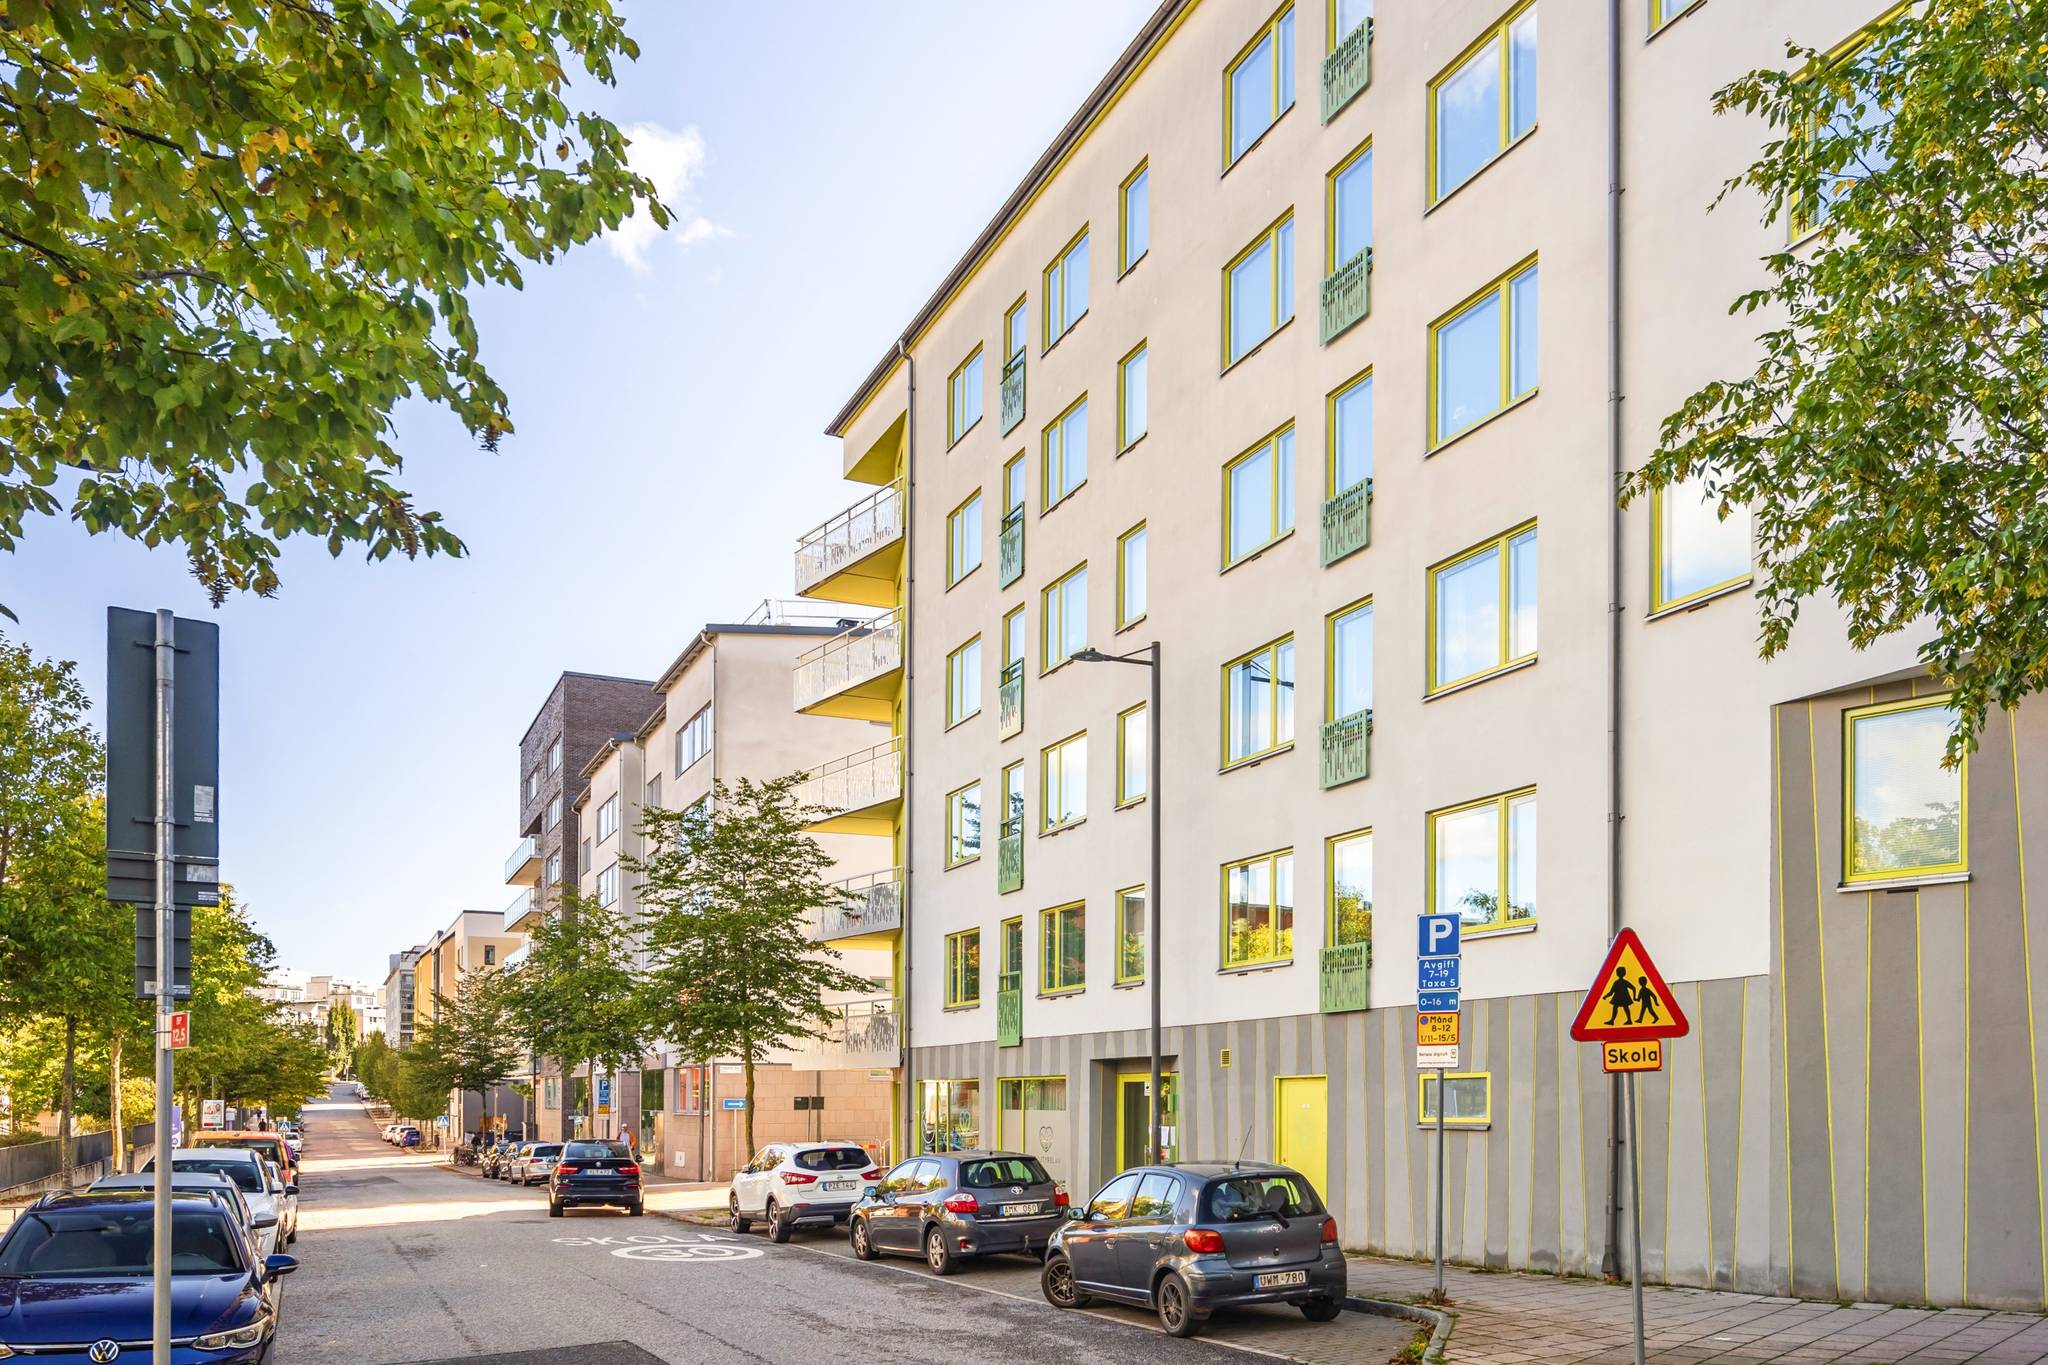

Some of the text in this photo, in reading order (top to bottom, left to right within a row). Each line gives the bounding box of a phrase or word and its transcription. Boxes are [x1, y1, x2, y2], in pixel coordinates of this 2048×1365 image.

[1429, 918, 1453, 953] P
[1423, 960, 1455, 970] Avgift
[1428, 969, 1449, 978] 7-19
[1422, 978, 1456, 988] Taxa 5
[1420, 997, 1457, 1006] 0-16 m
[1429, 1015, 1453, 1024] Månd
[1431, 1024, 1451, 1032] 8-12
[1420, 1034, 1456, 1042] 1/11-15/5
[1608, 1047, 1658, 1064] Skola
[601, 1080, 608, 1090] P
[1005, 1205, 1018, 1213] AMK
[1023, 1204, 1037, 1212] 060
[551, 1233, 740, 1246] SKOLA
[642, 1246, 735, 1258] 30
[1259, 1272, 1304, 1286] UWM 780
